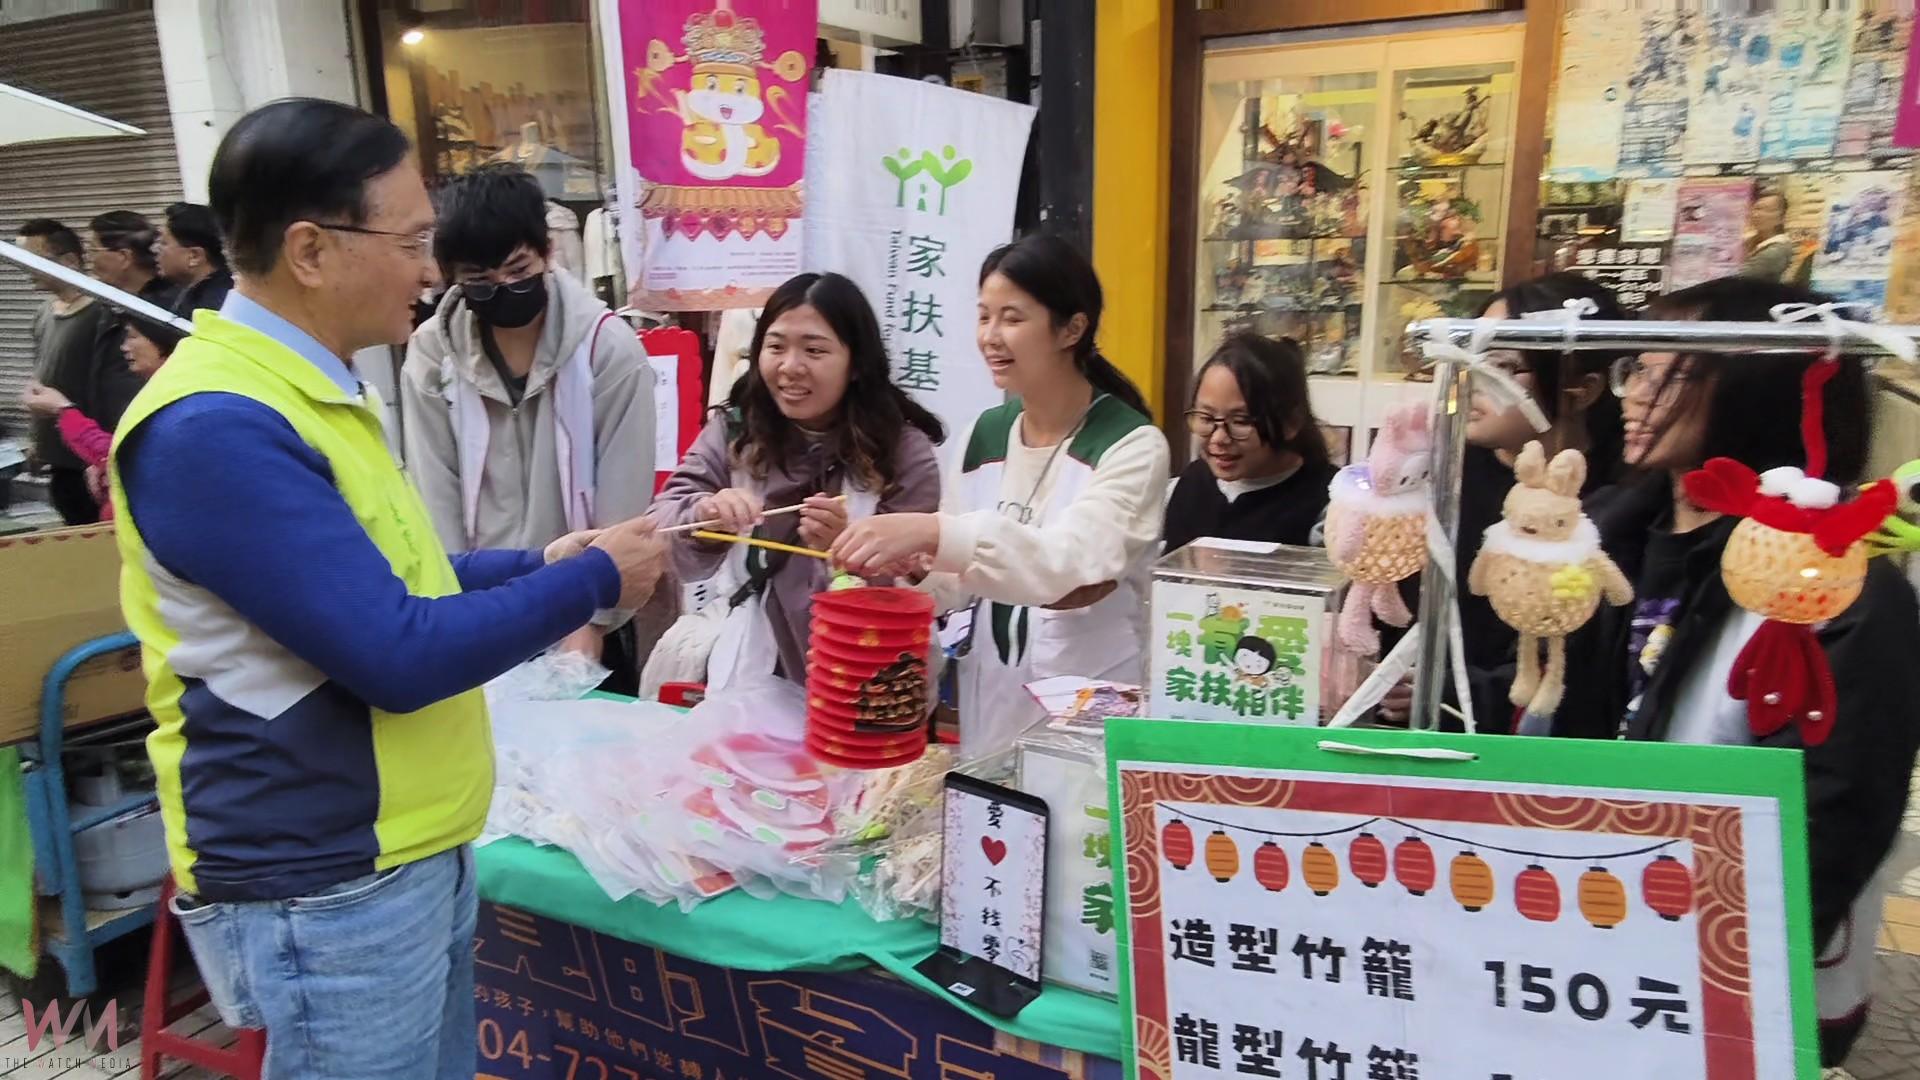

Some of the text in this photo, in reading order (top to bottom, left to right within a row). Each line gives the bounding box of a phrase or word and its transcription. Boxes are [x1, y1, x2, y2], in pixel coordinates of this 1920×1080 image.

[898, 235, 946, 391] 家扶基
[1165, 666, 1305, 720] 家扶相伴
[1170, 918, 1415, 1001] 造型竹籠
